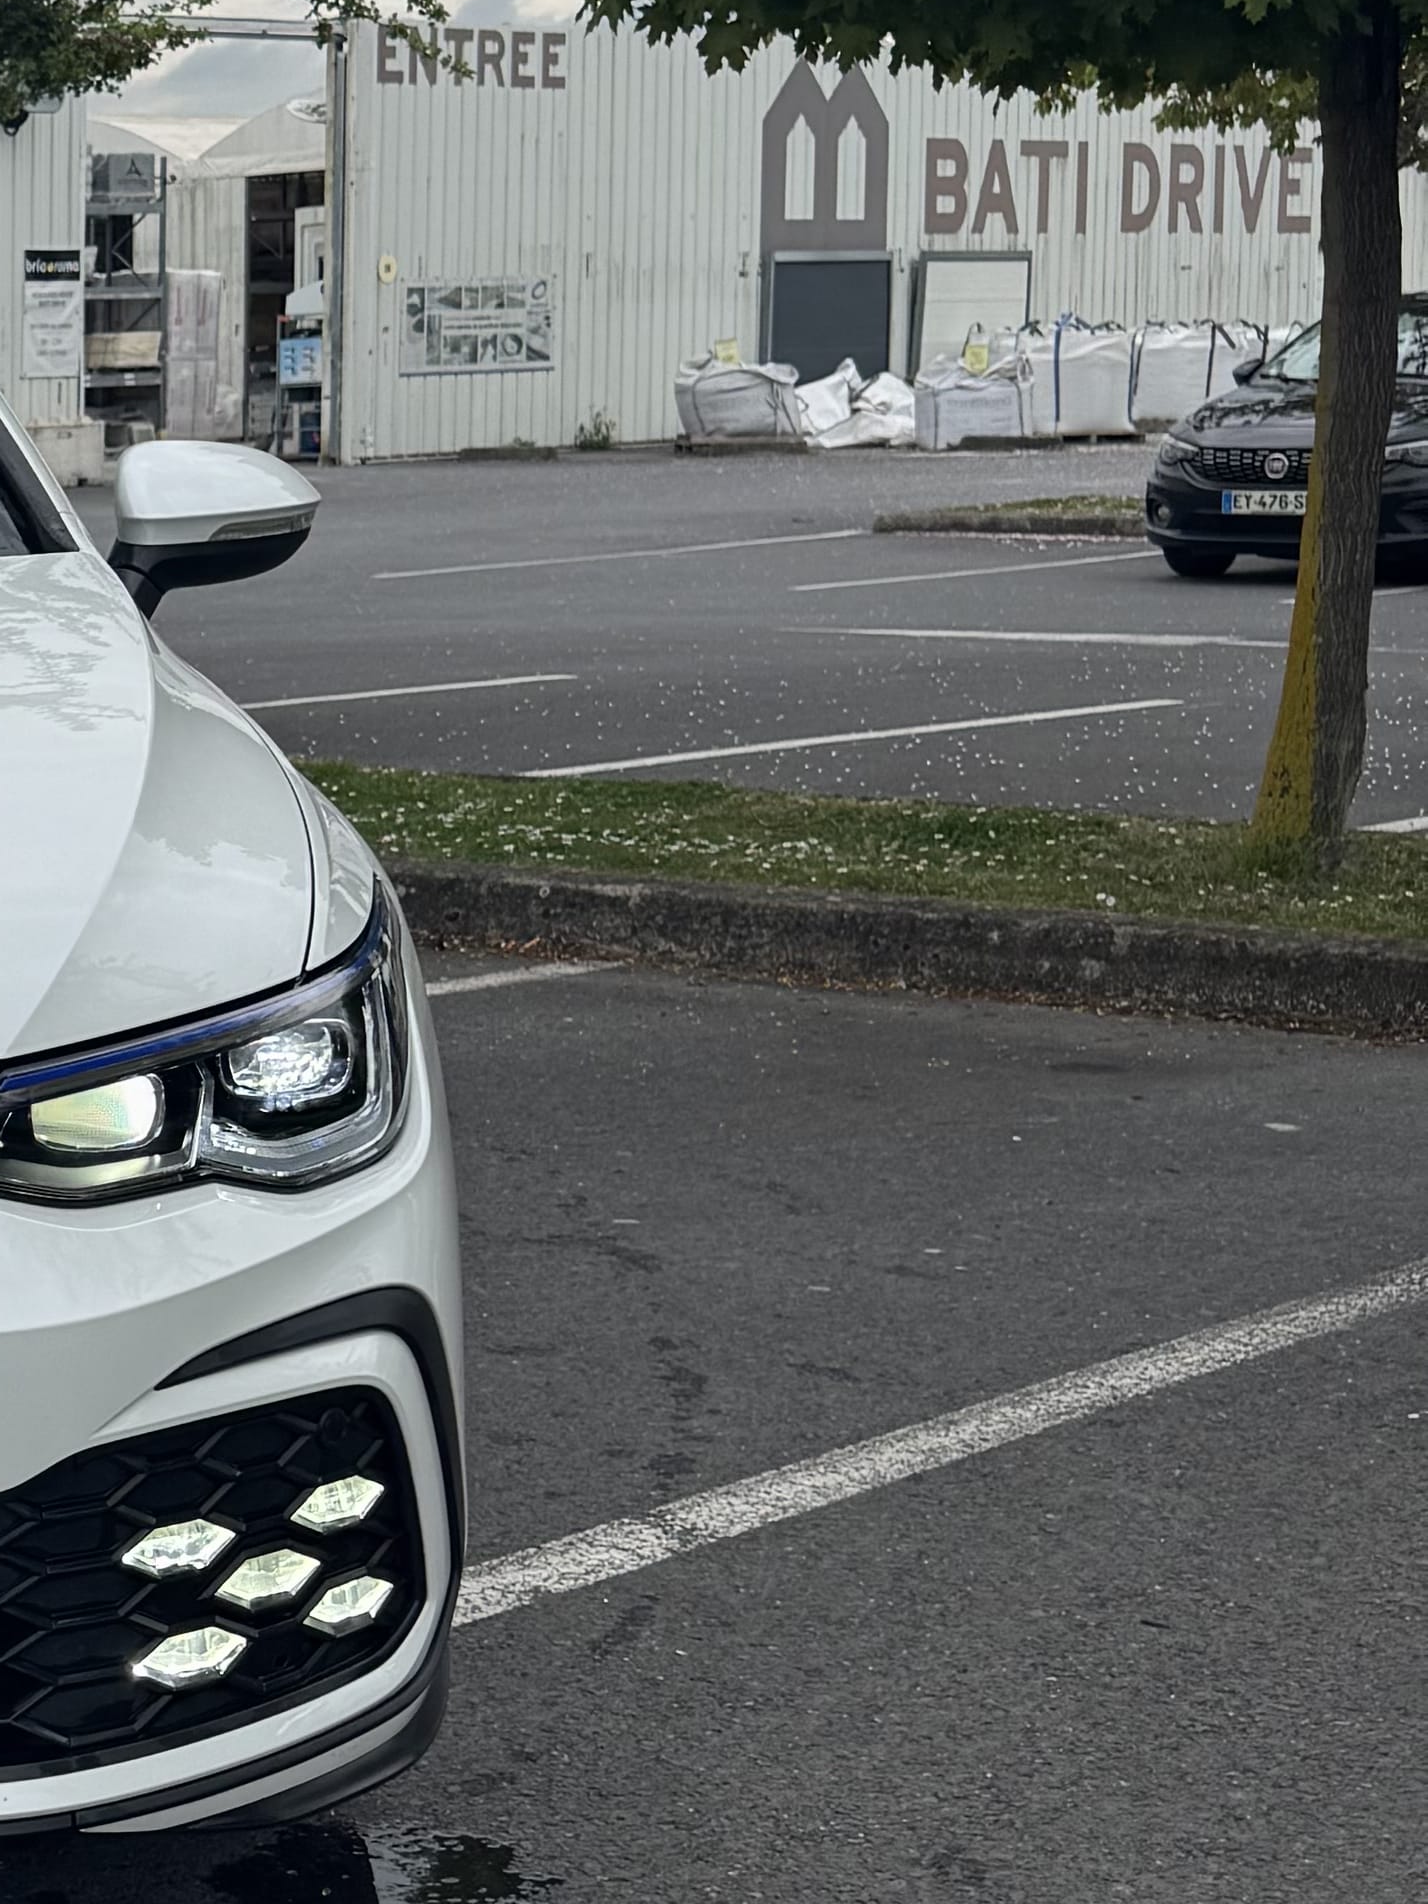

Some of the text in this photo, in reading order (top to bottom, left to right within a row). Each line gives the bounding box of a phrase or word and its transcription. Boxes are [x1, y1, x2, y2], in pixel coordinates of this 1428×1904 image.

[377, 24, 566, 89] ENTREE
[924, 138, 1313, 235] BATI DRIVE
[1233, 494, 1304, 510] EY-476-S
